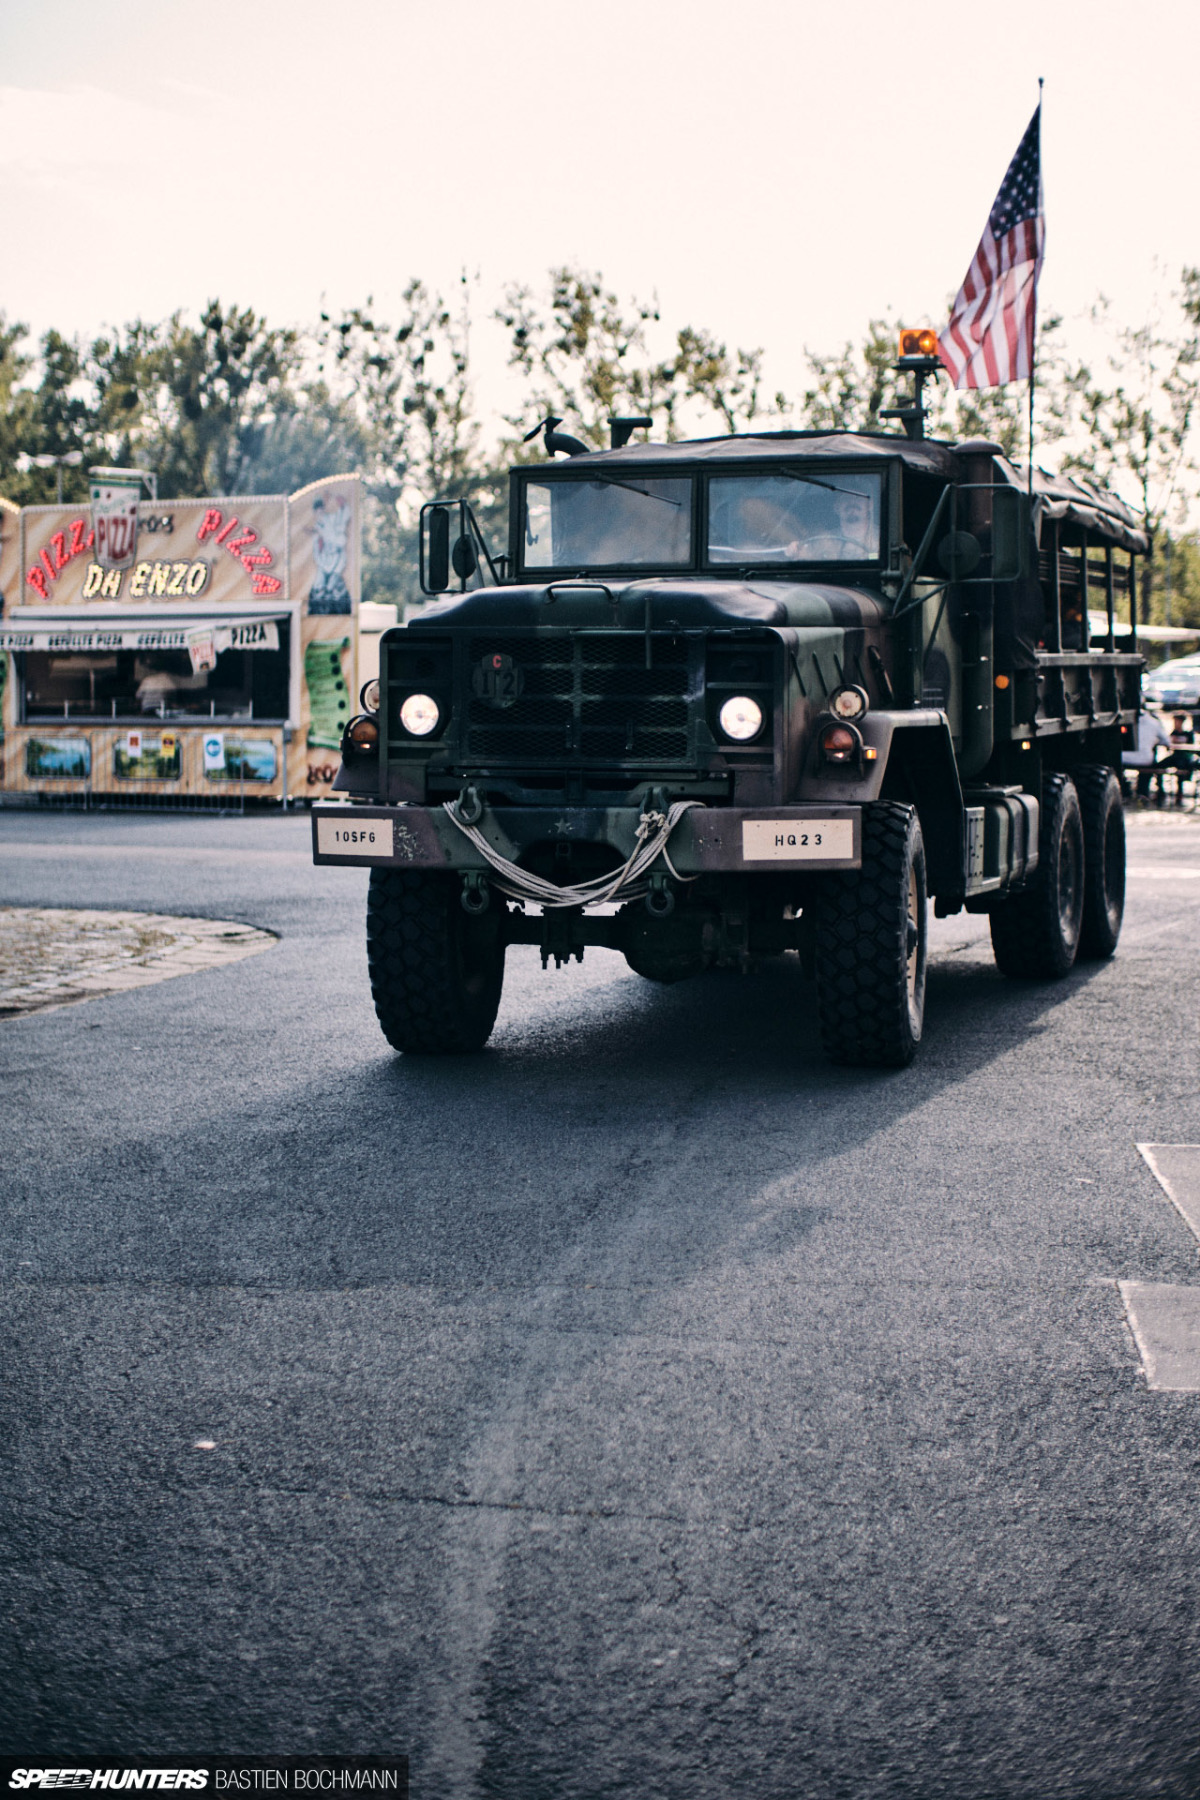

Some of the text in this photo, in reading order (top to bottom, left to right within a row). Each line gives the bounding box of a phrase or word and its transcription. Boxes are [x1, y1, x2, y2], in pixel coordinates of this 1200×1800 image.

[26, 519, 95, 599] PIZZ
[197, 508, 282, 594] PIZZA
[82, 561, 208, 598] DA ENZO
[231, 623, 267, 646] PIZZA
[335, 830, 376, 843] 10SFG
[775, 833, 823, 846] HQ23
